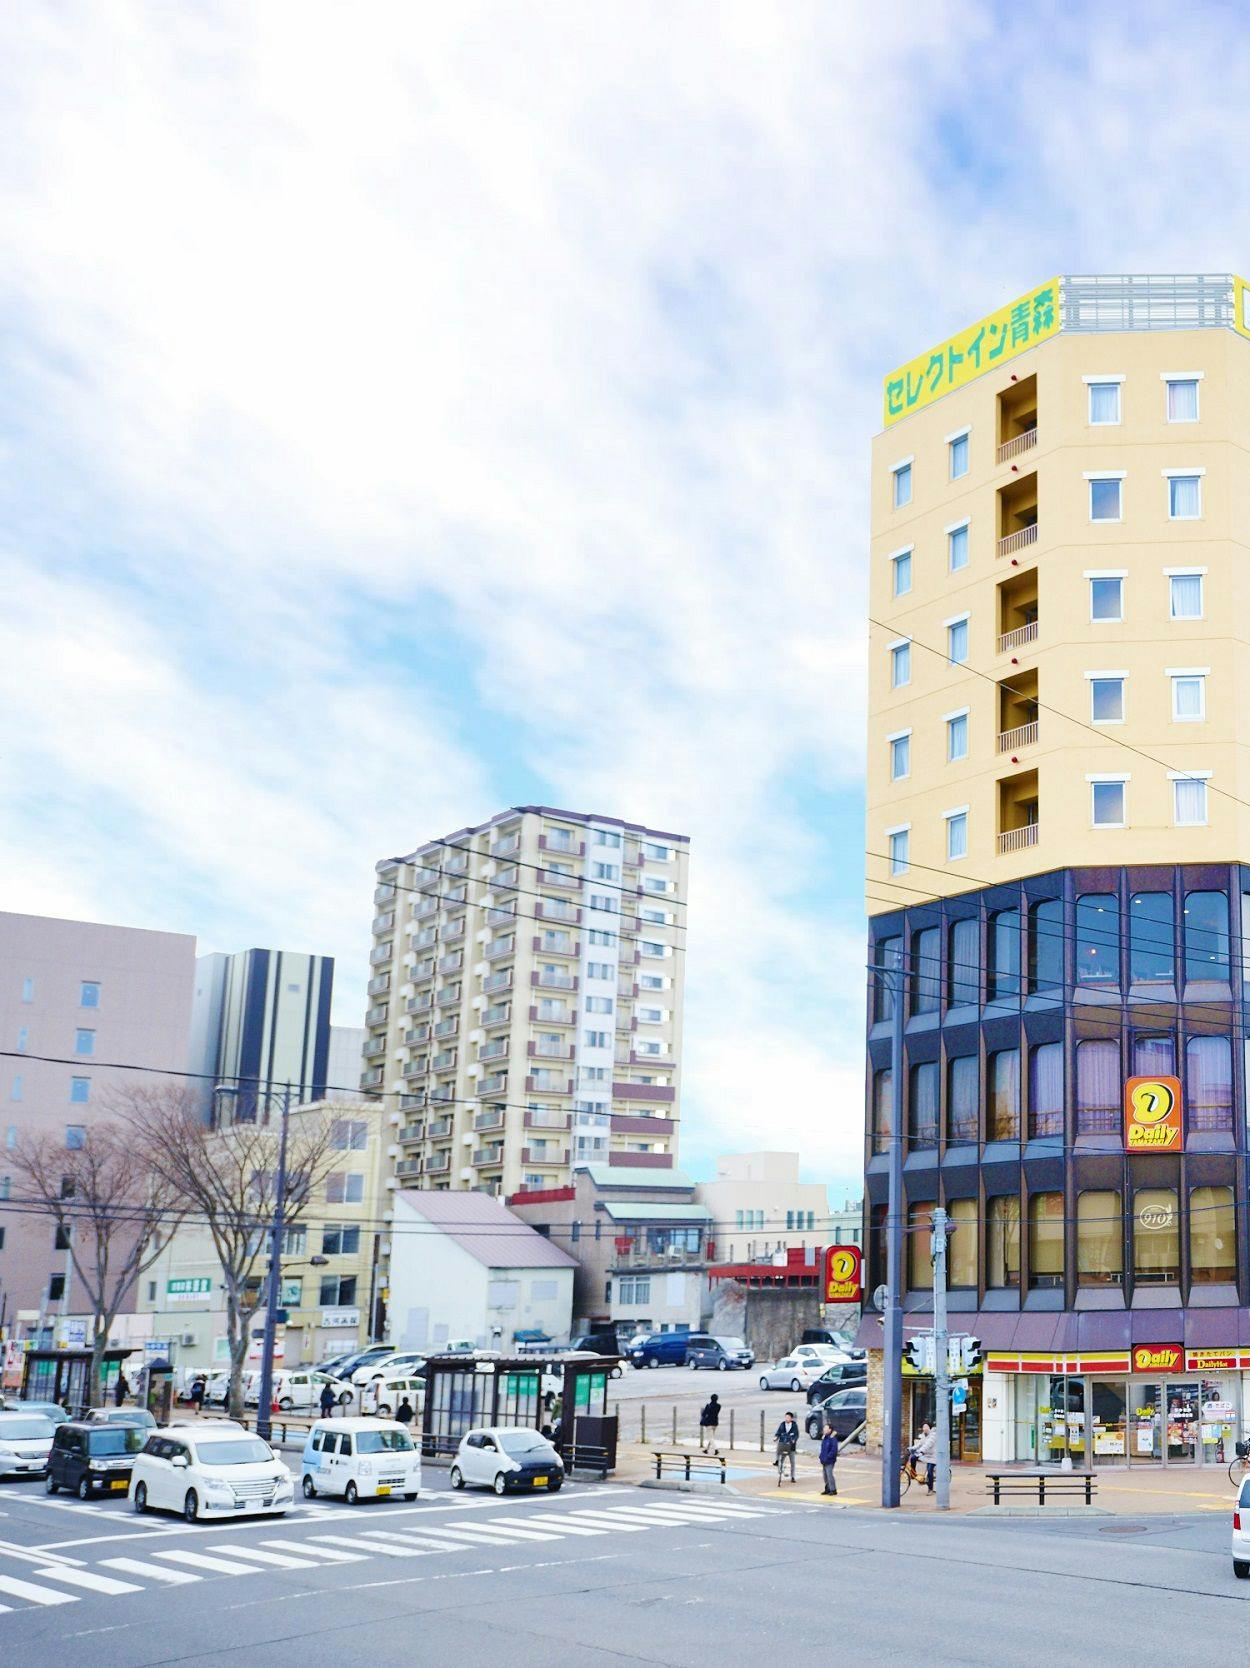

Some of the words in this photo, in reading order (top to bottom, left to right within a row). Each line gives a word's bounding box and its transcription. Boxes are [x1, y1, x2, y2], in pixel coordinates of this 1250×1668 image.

[887, 288, 1053, 415] セレクトイン青森
[1128, 1123, 1179, 1146] Daily
[829, 1281, 859, 1298] Daily
[1135, 1349, 1180, 1368] Daily
